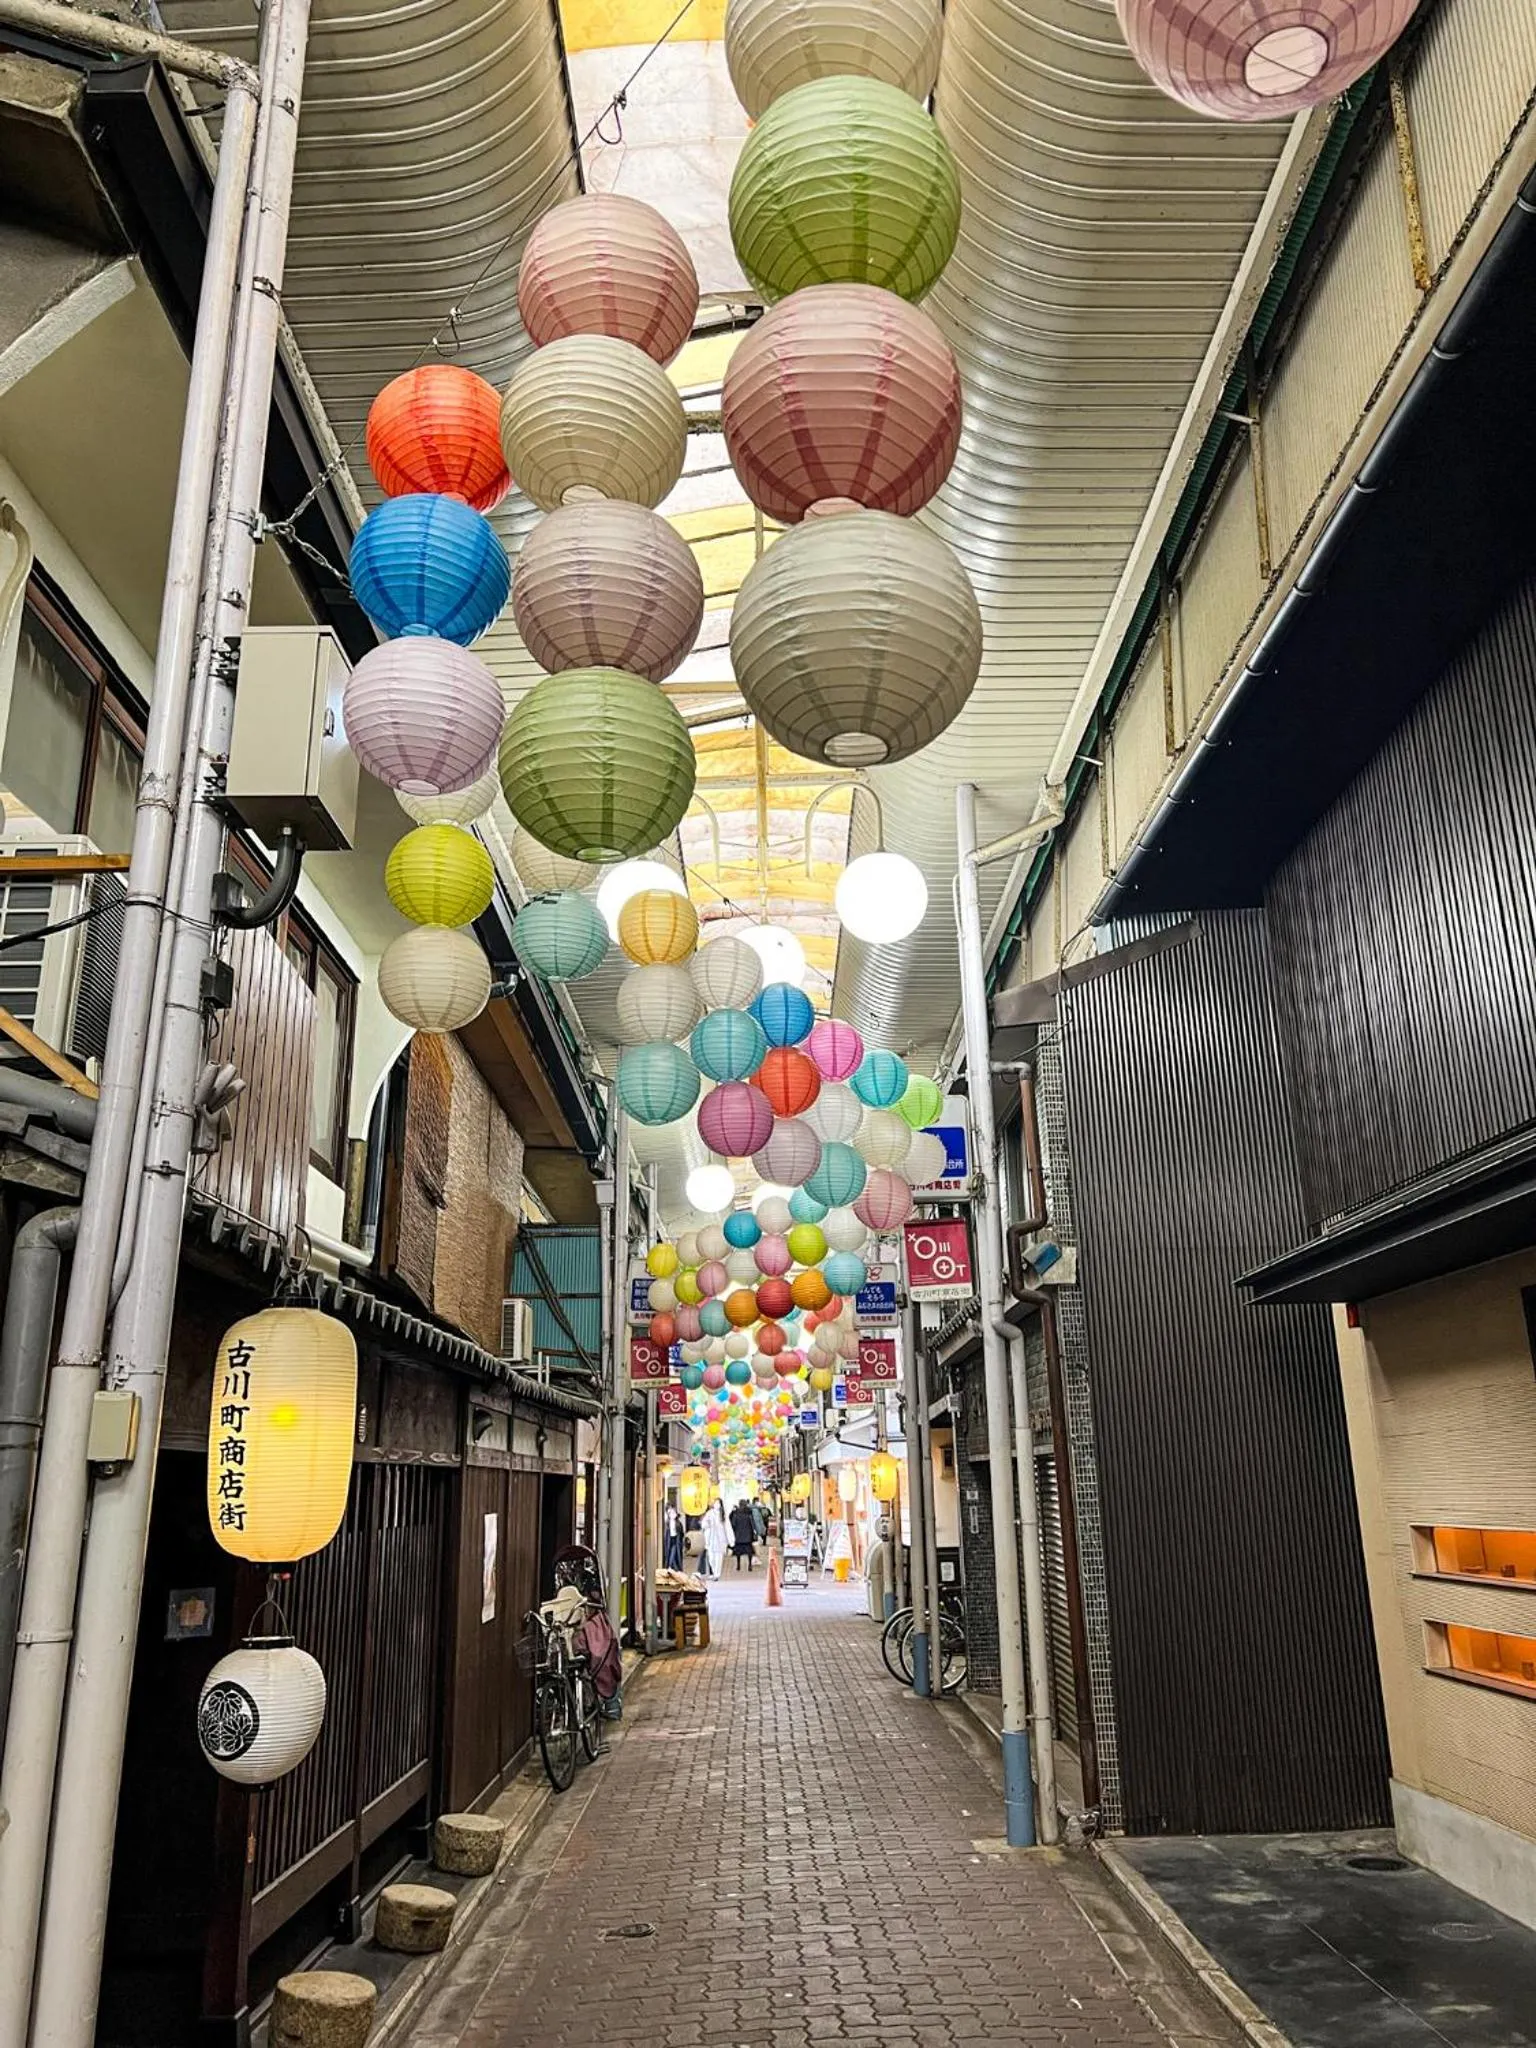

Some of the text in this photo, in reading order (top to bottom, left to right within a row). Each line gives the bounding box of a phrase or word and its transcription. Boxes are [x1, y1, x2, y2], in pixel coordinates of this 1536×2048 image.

[217, 1340, 256, 1531] 古川町商店街
